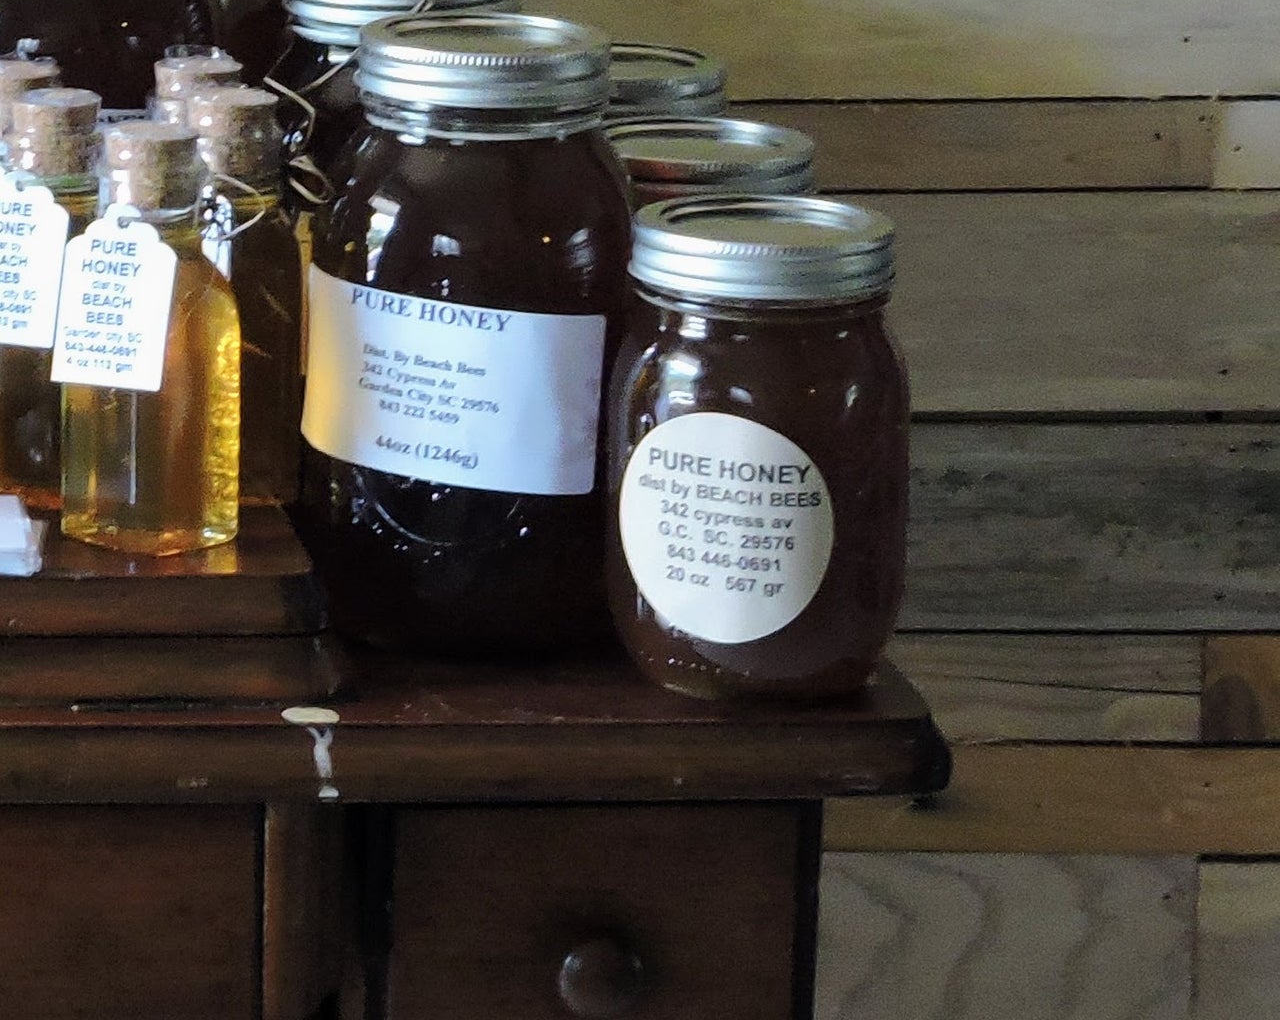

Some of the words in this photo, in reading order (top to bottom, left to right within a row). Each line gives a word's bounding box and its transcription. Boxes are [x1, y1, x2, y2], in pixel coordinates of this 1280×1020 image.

[91, 239, 137, 256] PURE
[82, 260, 141, 277] HONEY
[82, 293, 132, 308] BEACH
[351, 287, 411, 317] PURE
[419, 302, 512, 332] HONEY
[86, 311, 123, 325] BEES
[393, 349, 410, 366] By
[413, 354, 452, 372] Beach
[408, 386, 433, 406] City
[403, 404, 424, 419] 222
[376, 435, 410, 454] 44oz
[415, 442, 480, 470] (1246g)
[649, 448, 712, 476] PURE
[719, 460, 811, 484] HONEY
[671, 479, 691, 499] by
[696, 484, 762, 506] BEACH
[769, 492, 821, 506] BEES
[661, 499, 689, 518] 342
[694, 509, 764, 528] cypress
[771, 518, 793, 528] av
[658, 521, 692, 541] G.C.
[740, 534, 794, 550] 29576
[667, 544, 695, 561] 843
[665, 564, 685, 581] 20
[691, 573, 709, 587] oz
[725, 576, 756, 592] 567
[764, 582, 784, 597] gr
